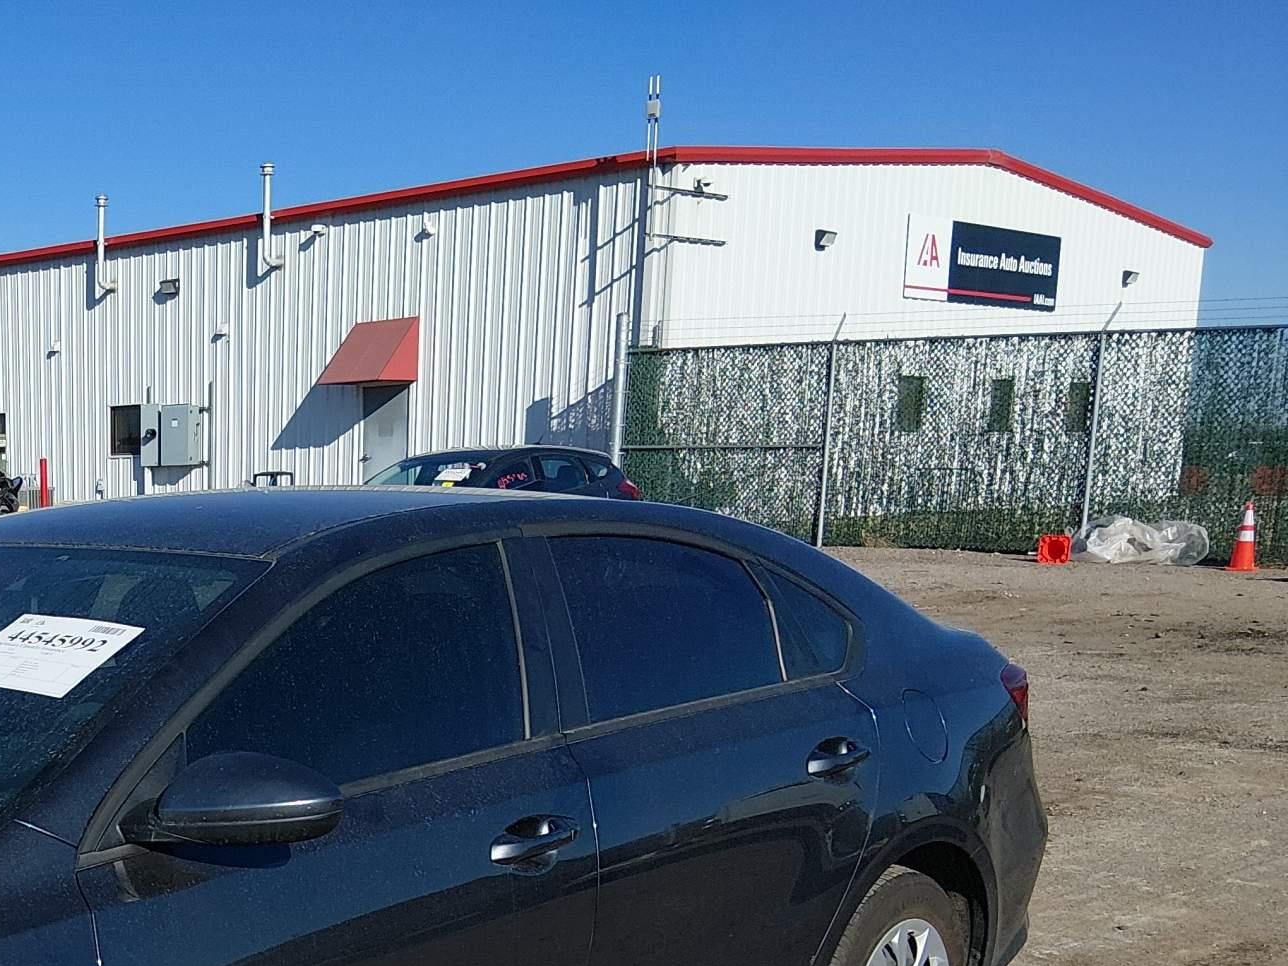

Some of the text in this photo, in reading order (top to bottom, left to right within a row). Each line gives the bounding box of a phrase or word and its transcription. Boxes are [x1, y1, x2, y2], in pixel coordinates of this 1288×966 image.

[957, 247, 1053, 277] Insurance Auto Auctions
[7, 629, 108, 653] 44545992
